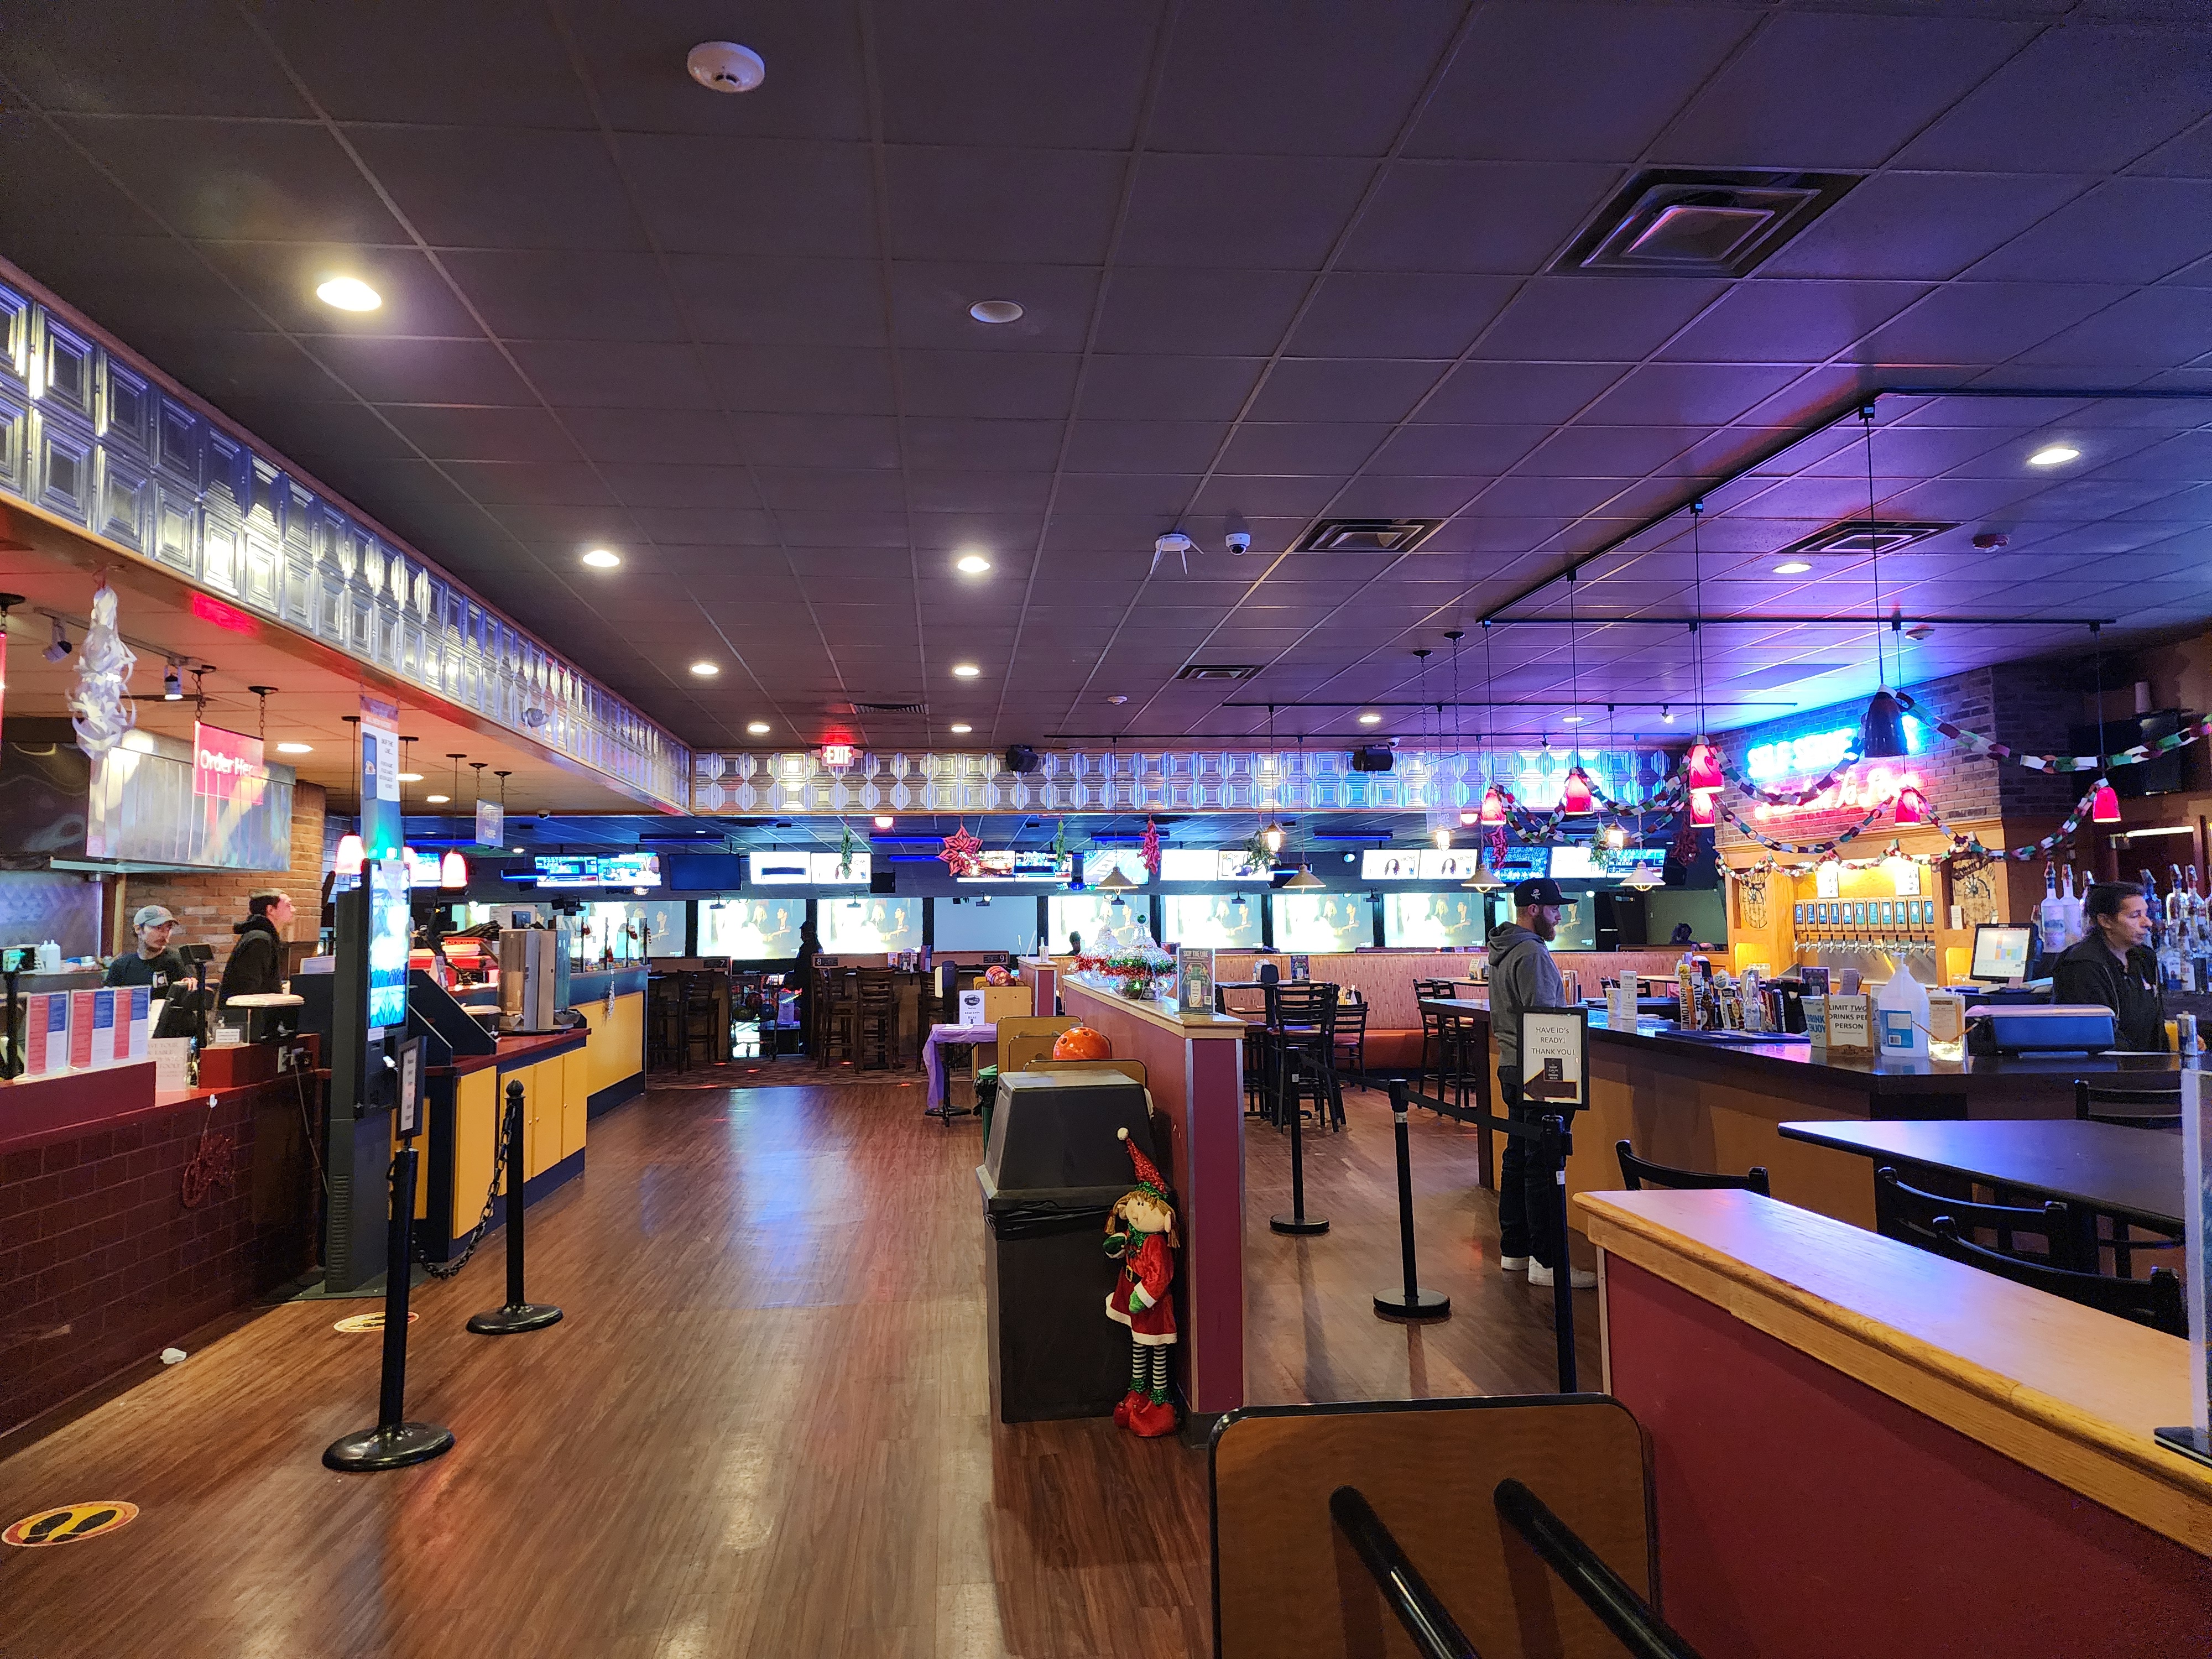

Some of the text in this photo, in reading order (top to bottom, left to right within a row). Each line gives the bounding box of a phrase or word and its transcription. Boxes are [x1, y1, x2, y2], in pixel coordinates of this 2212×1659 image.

[200, 749, 234, 773] Order
[827, 746, 849, 764] EXIT
[1747, 742, 1790, 778] SELF
[1437, 812, 1450, 823] Here
[1693, 983, 1703, 1011] TRULY
